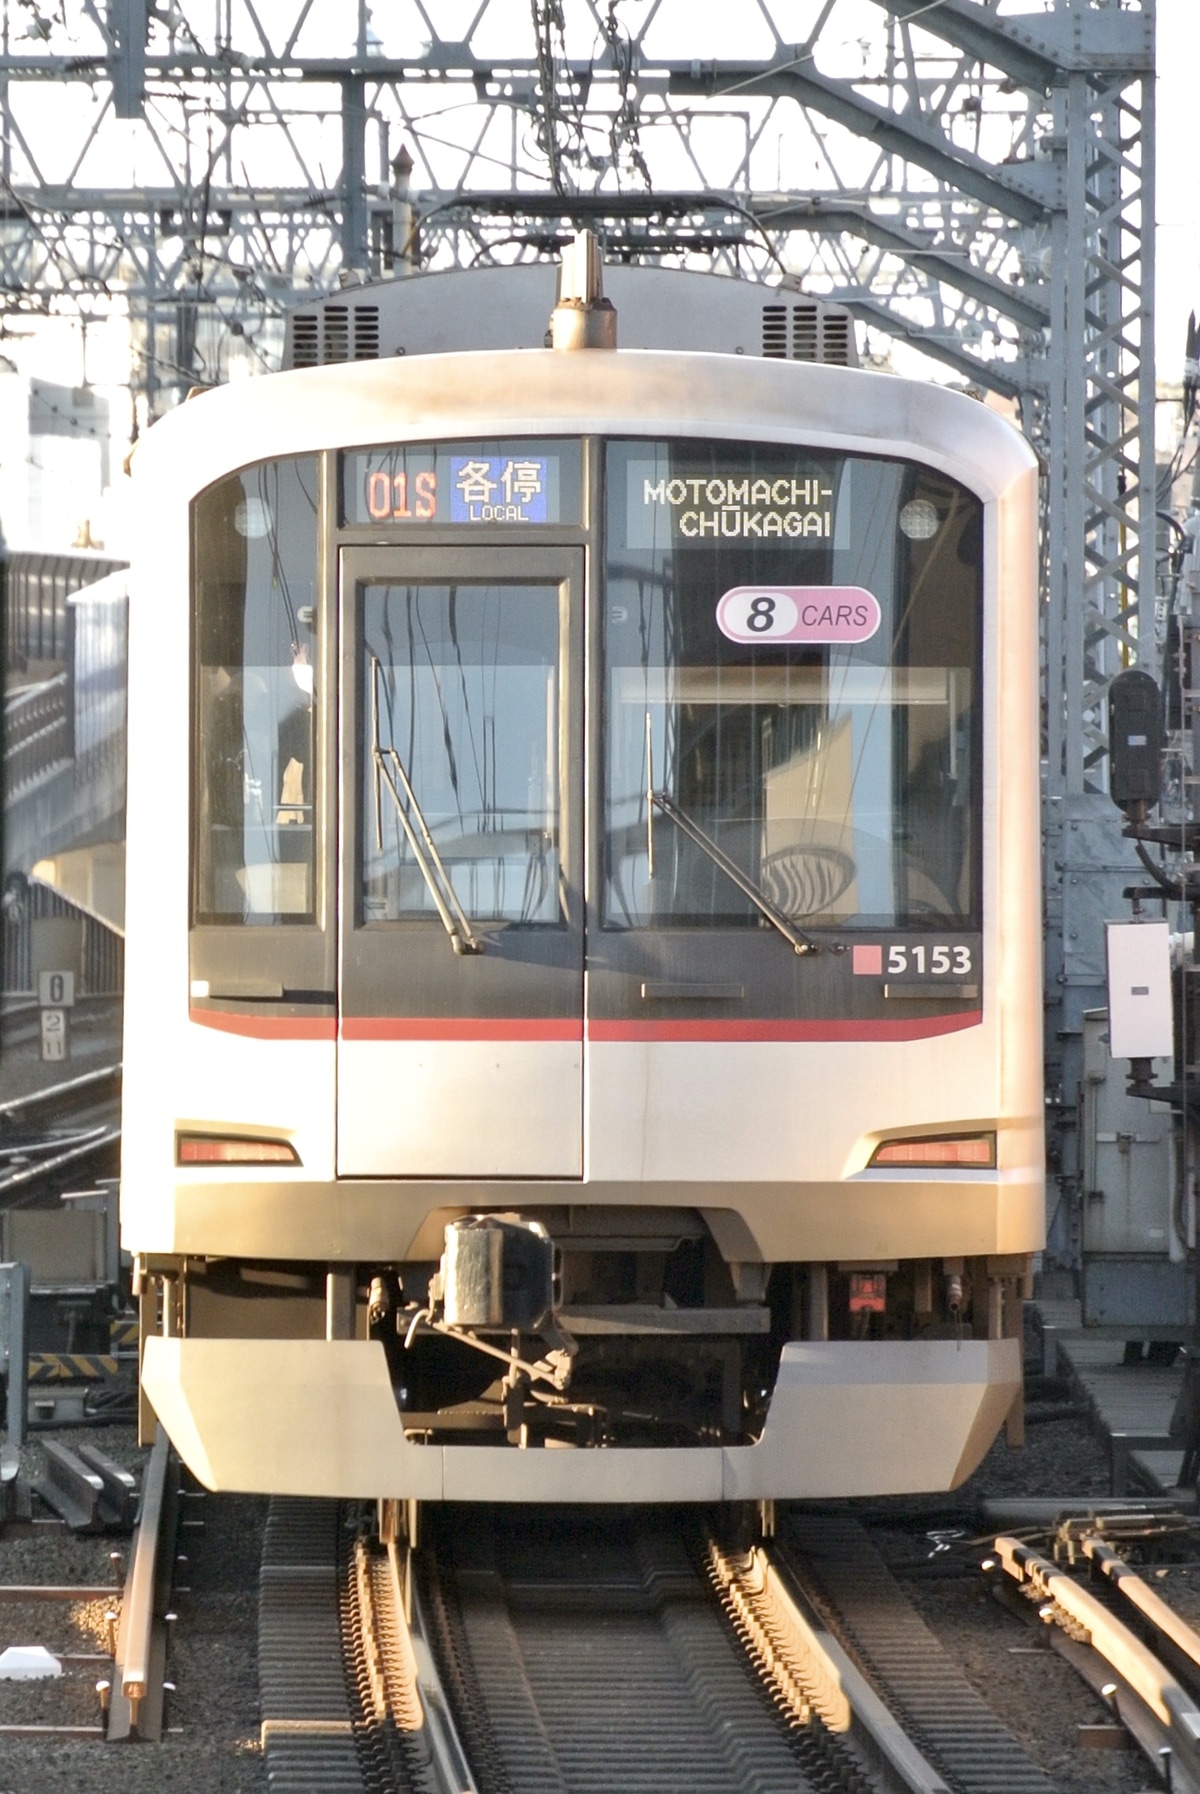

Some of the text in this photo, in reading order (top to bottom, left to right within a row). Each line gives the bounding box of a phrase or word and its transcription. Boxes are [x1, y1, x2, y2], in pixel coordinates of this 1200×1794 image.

[369, 472, 437, 518] 01S
[456, 461, 541, 503] 各停
[643, 479, 833, 505] MOTOMACHI-
[470, 505, 529, 521] LOCAL
[679, 505, 831, 537] CHŪKAGAI
[747, 597, 867, 632] 8 CARS
[887, 945, 972, 974] 5153
[50, 974, 64, 1003] 0
